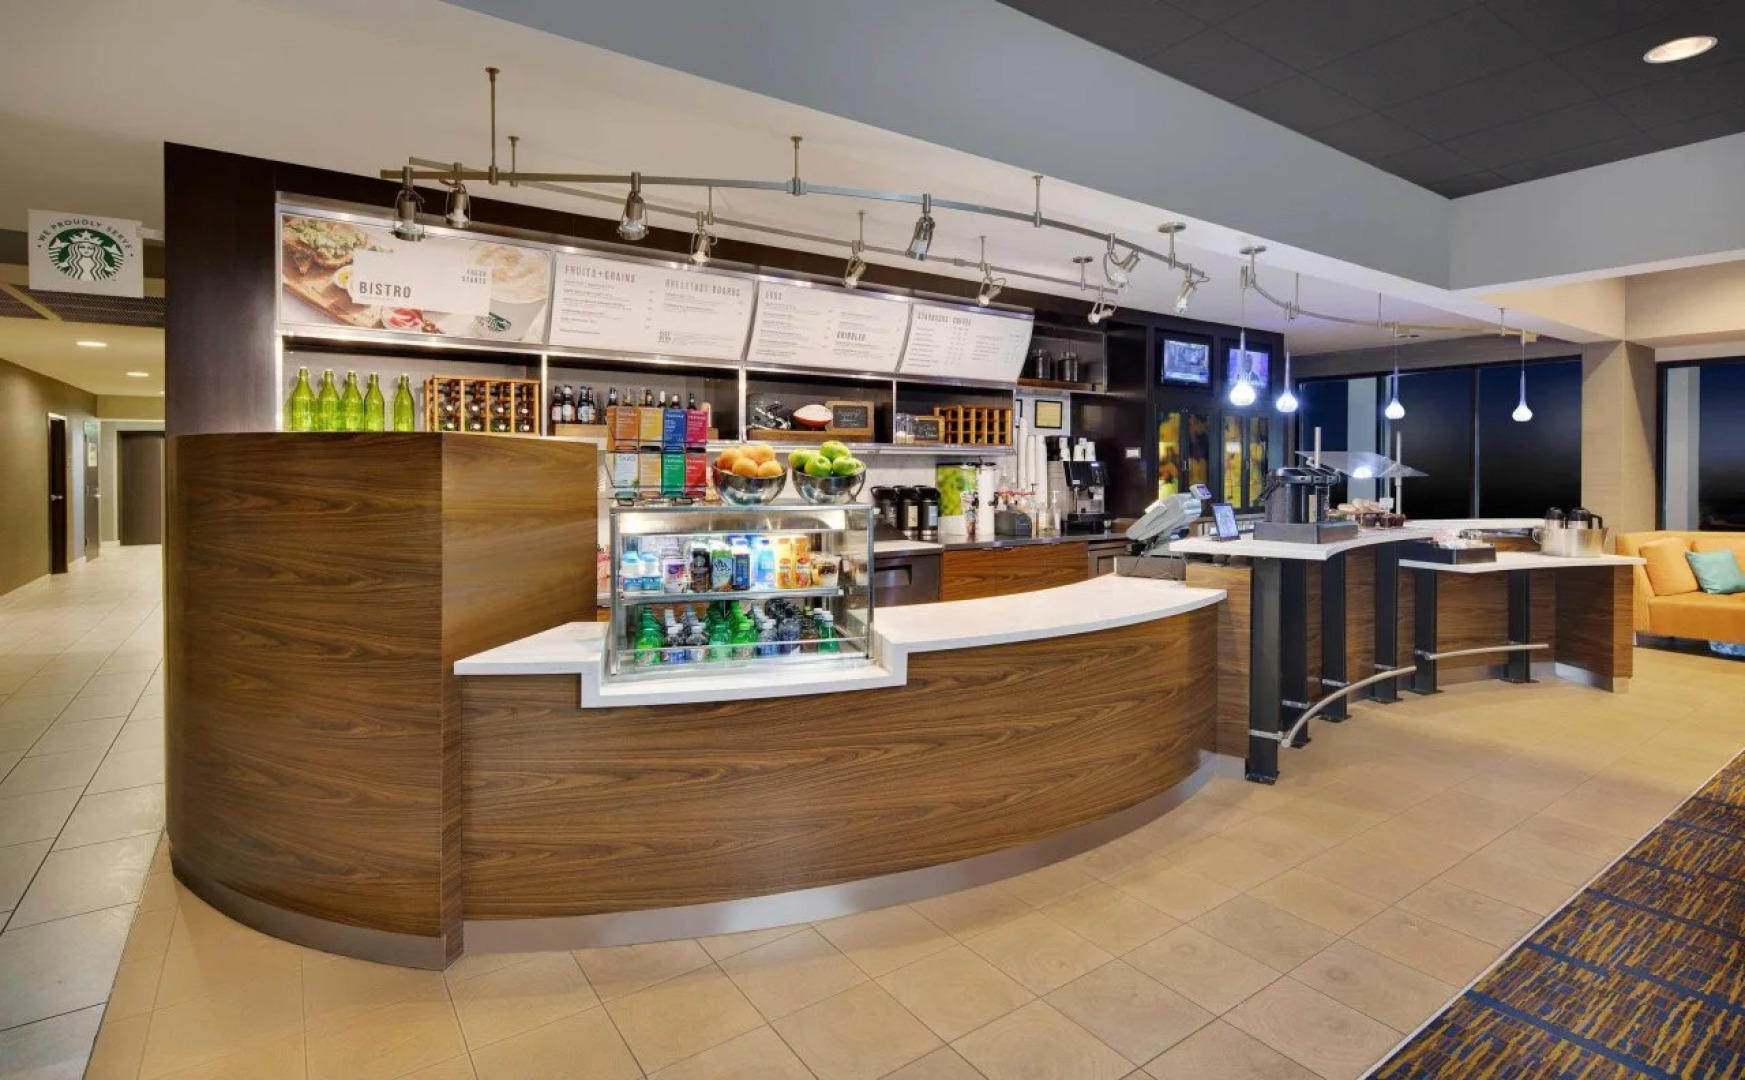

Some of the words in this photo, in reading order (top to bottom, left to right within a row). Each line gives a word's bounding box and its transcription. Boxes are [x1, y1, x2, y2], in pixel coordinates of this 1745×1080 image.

[38, 230, 50, 242] WE
[50, 219, 102, 230] PROUDLY
[106, 226, 133, 249] SERVE
[359, 281, 412, 299] BISTRO
